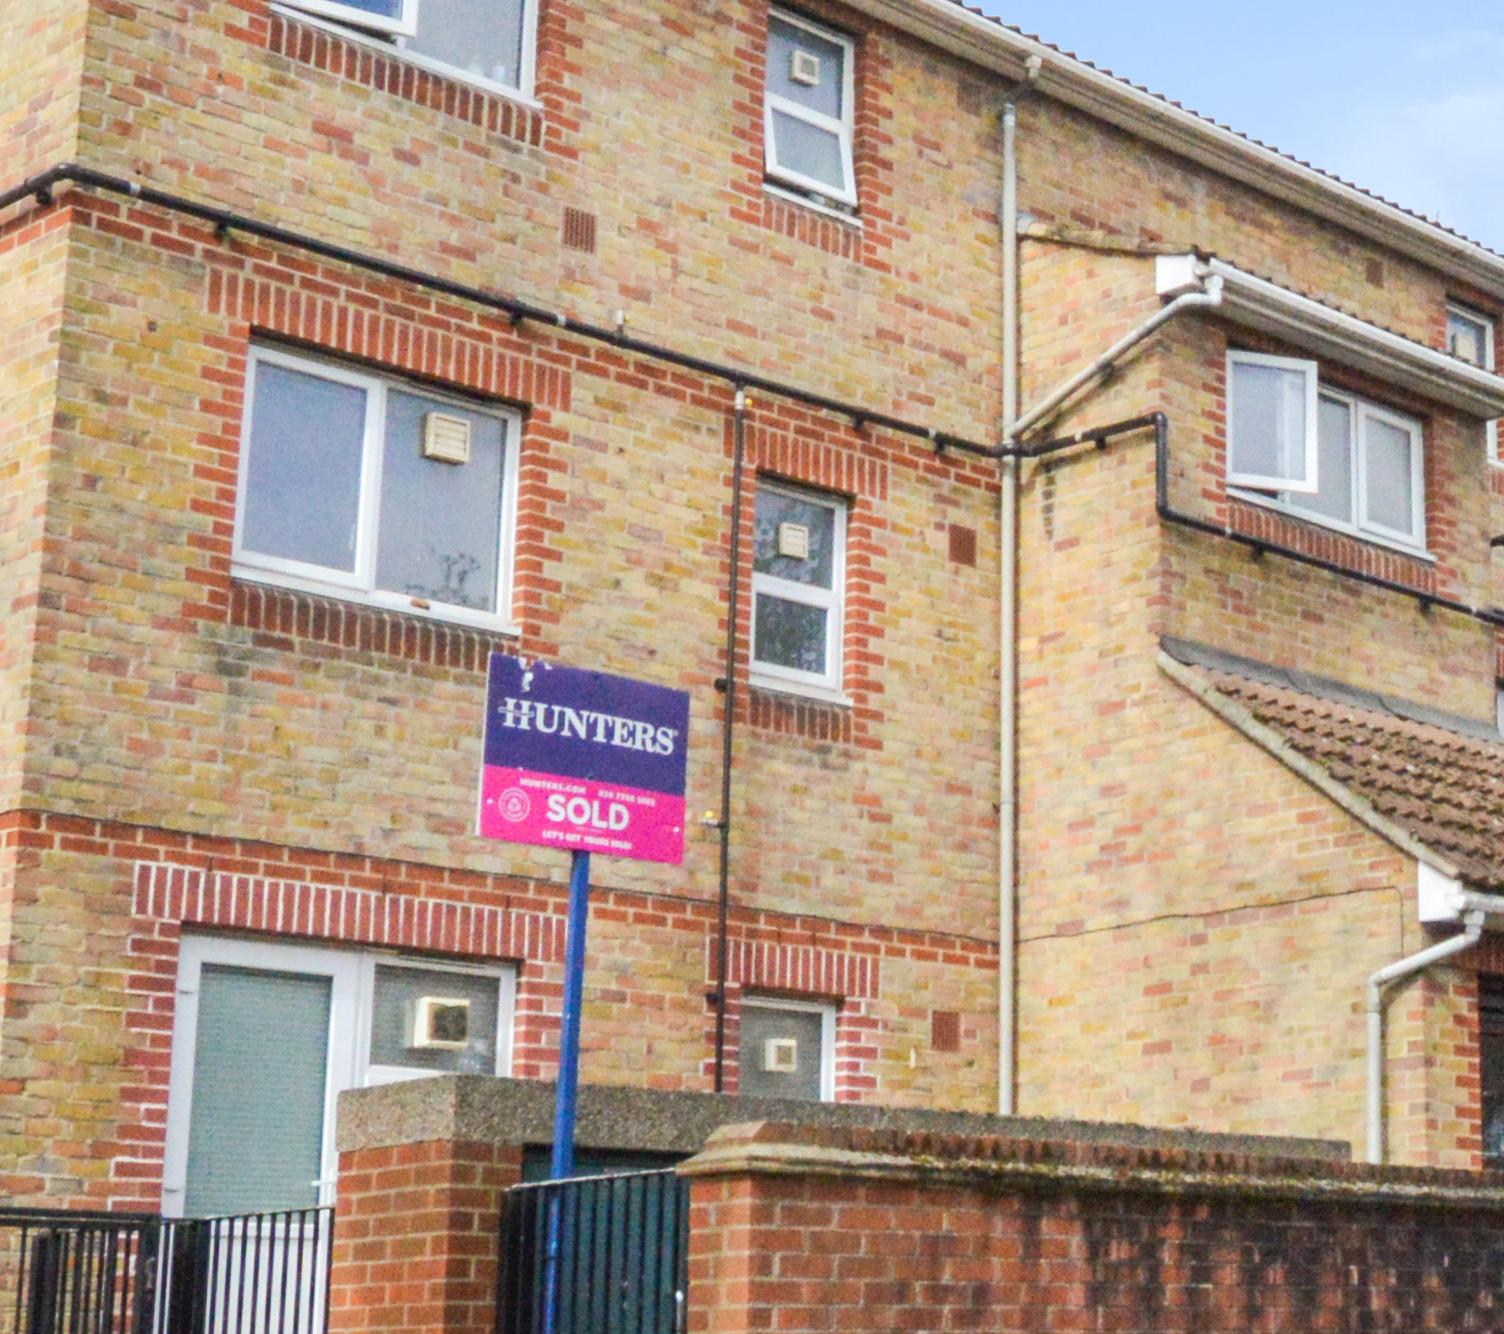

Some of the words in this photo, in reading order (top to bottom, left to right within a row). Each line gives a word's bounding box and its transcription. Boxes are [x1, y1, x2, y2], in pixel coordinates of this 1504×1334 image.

[498, 697, 676, 756] HUNTERS
[520, 778, 586, 795] HUNTERS.COM
[546, 794, 629, 831] SOLD
